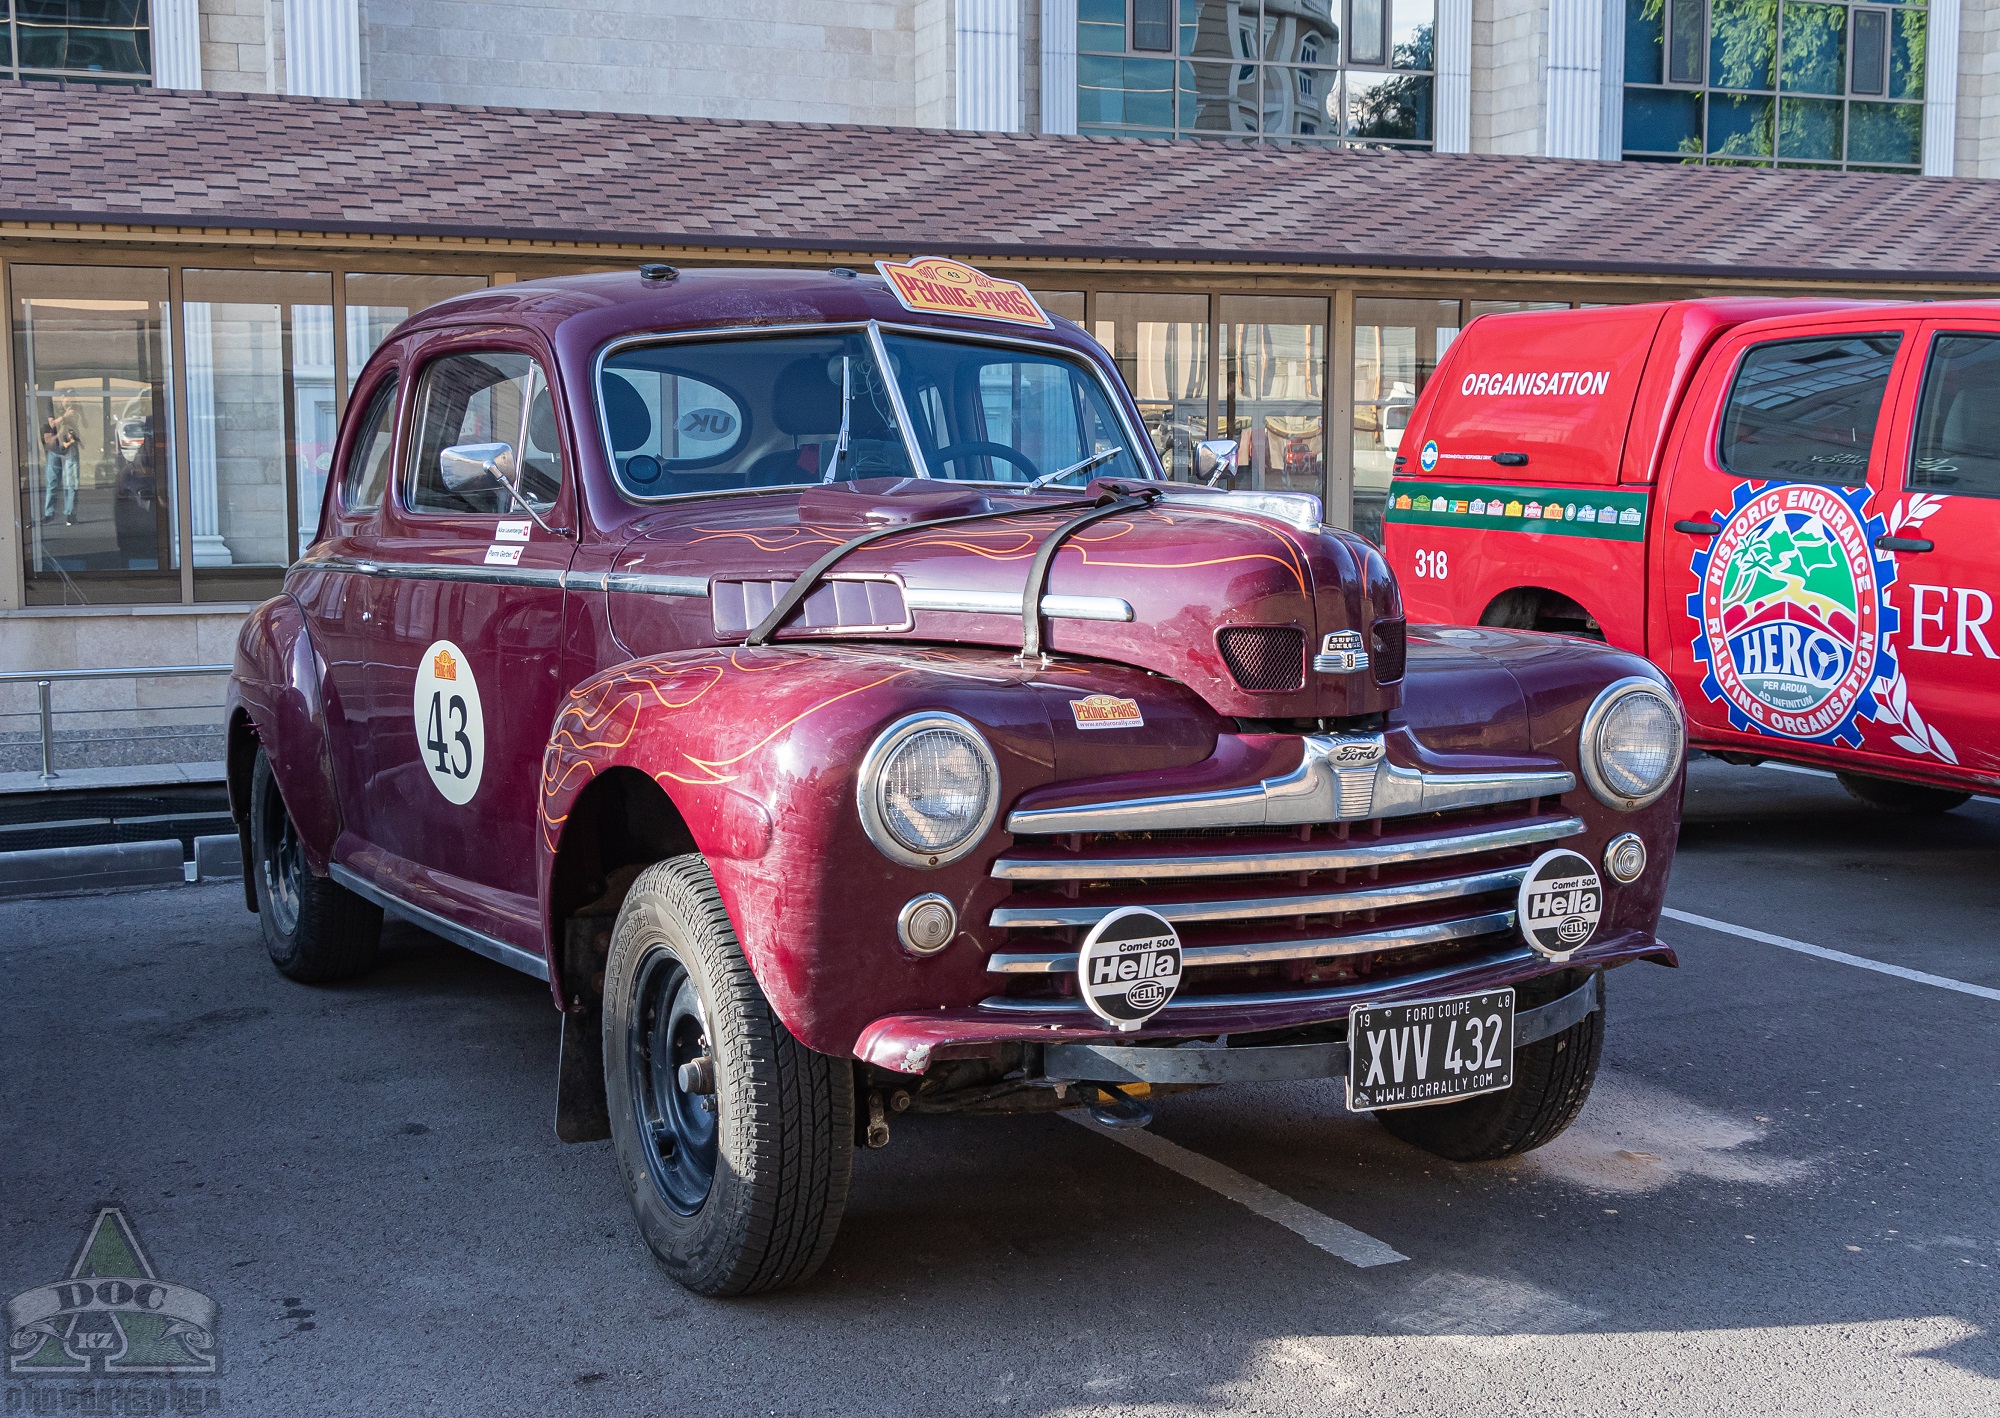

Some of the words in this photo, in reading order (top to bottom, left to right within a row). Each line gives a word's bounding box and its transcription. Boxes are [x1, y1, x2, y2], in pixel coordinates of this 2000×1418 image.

[916, 265, 938, 281] 1907
[947, 271, 961, 279] 43
[970, 272, 995, 289] 2024
[895, 271, 979, 309] PEKING
[974, 289, 1037, 319] PARIS
[1461, 371, 1610, 396] ORGANISATION
[1711, 493, 1780, 586] HISTORIC
[1785, 490, 1872, 593] ENDURANCE
[1414, 548, 1448, 580] 318
[1908, 583, 2000, 660] ER
[1346, 653, 1354, 668] 8
[1741, 624, 1845, 686] HERO
[1706, 617, 1764, 720] RALLYING
[1770, 630, 1874, 734] ORGANISATION
[1763, 680, 1778, 691] PER
[1780, 682, 1808, 694] ARDUA
[1758, 691, 1771, 703] AD
[1772, 694, 1814, 708] INFINITUM
[1074, 703, 1108, 719] PEKING
[1109, 701, 1138, 718] PARIS
[427, 690, 473, 780] 43
[1336, 745, 1379, 763] Ford
[1552, 879, 1579, 890] Comet
[1581, 878, 1597, 886] 500
[1531, 890, 1597, 918] Hella
[1561, 922, 1588, 934] HELLA
[1119, 941, 1152, 952] Comet
[1156, 938, 1175, 948] 500
[1093, 952, 1175, 984] Hella
[1130, 985, 1165, 1000] HELLA
[1497, 995, 1510, 1008] 48
[1359, 1013, 1371, 1027] 19
[1406, 1006, 1435, 1022] FORD
[1438, 1001, 1470, 1018] COUPE
[1364, 1024, 1432, 1087] XVV
[1444, 1013, 1503, 1075] 432
[1375, 1072, 1493, 1103] WWW.OCRRALLY.COM
